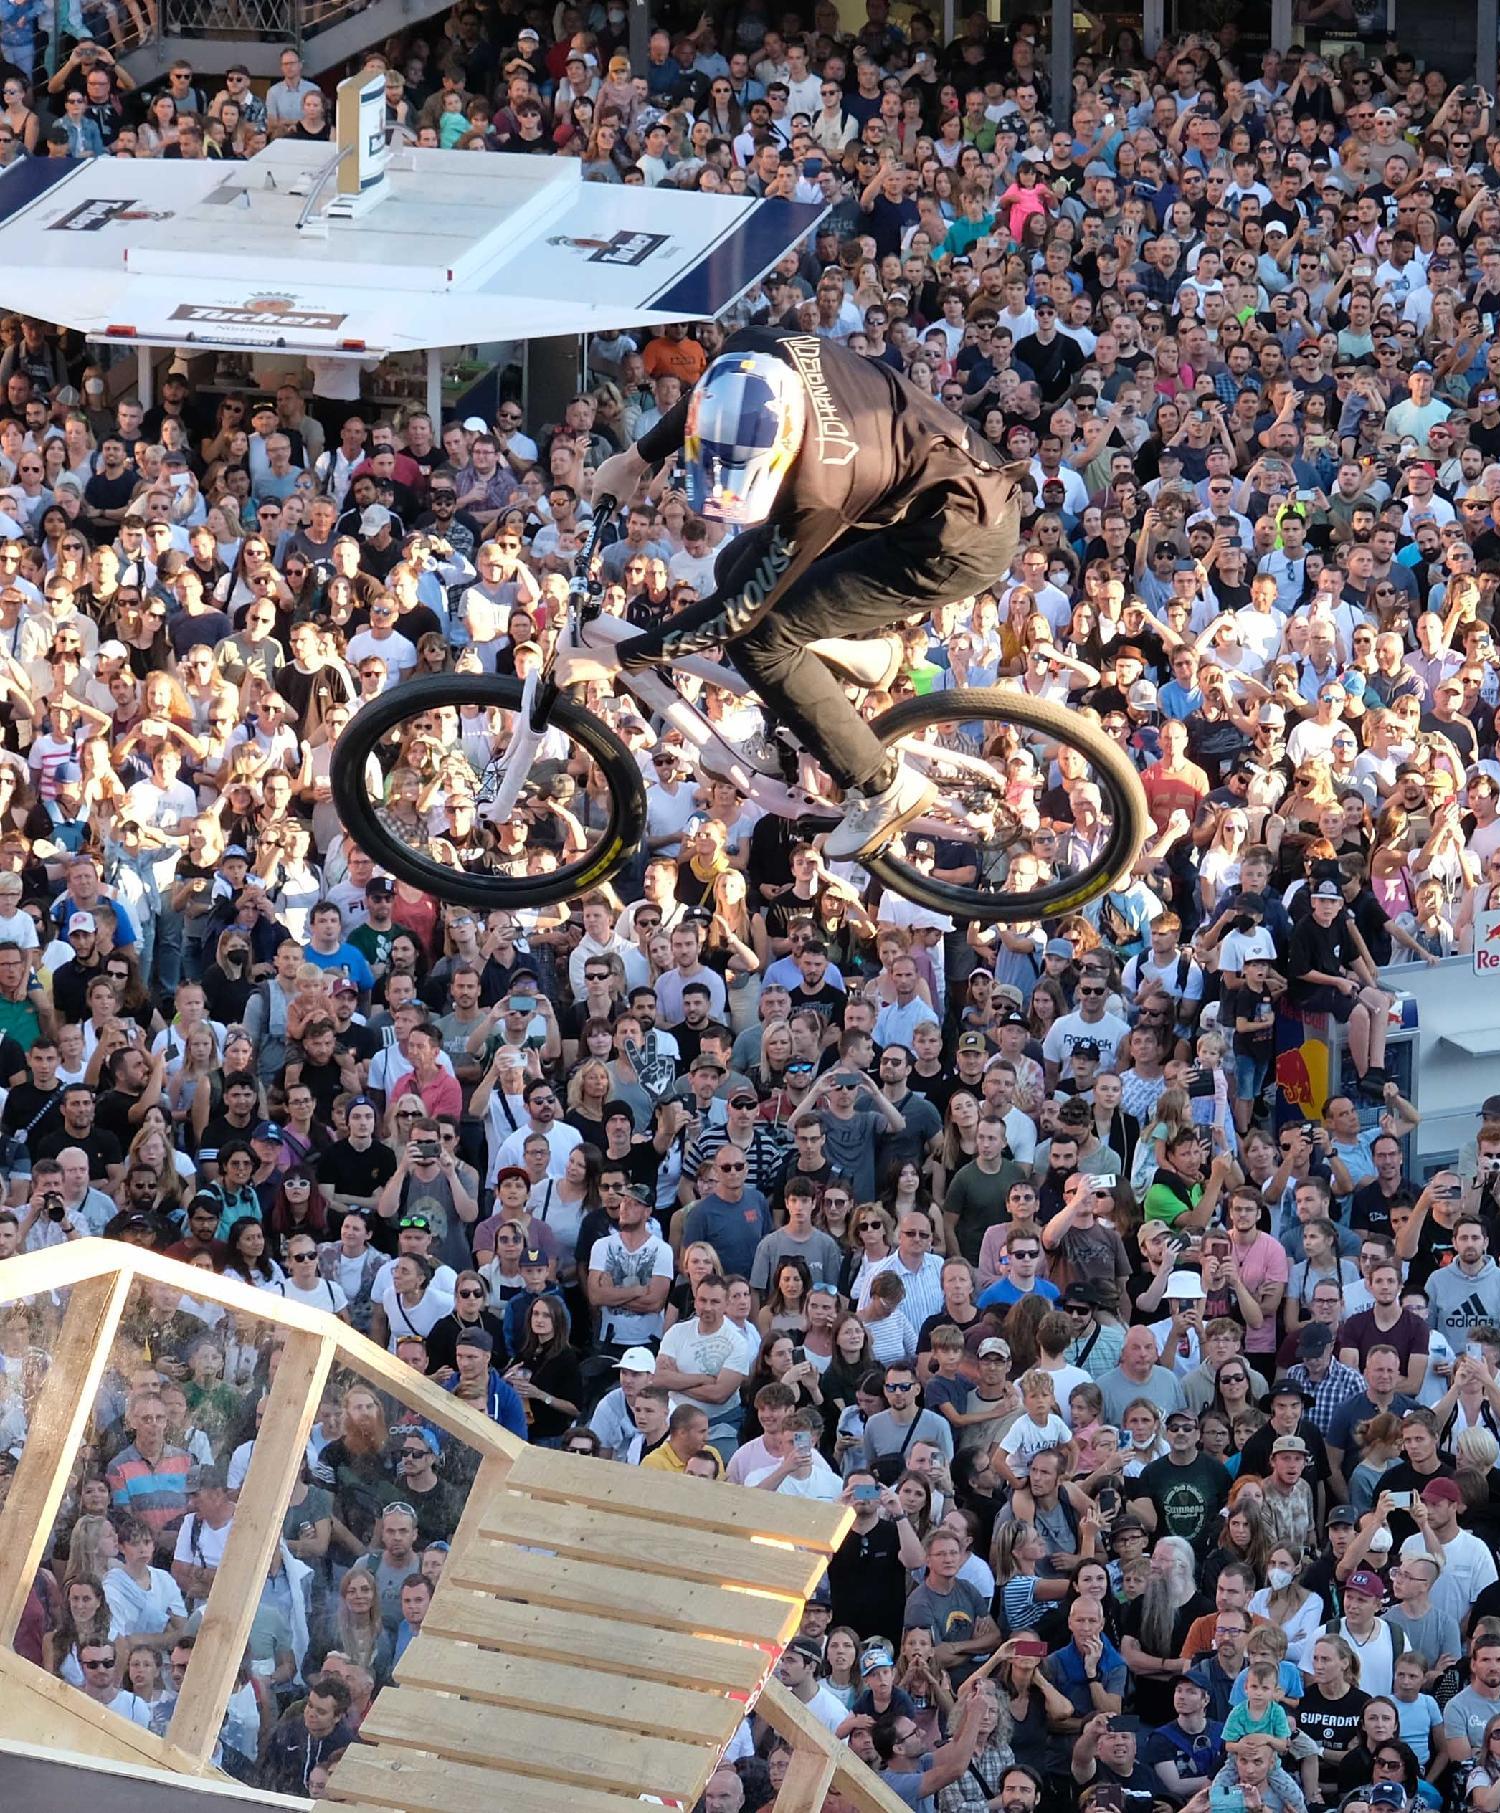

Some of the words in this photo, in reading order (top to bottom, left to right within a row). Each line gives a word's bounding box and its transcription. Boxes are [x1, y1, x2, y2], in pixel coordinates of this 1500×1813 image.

[187, 307, 332, 326] Tucher
[1446, 1313, 1494, 1328] adidas
[1301, 1712, 1360, 1727] SUPERDRY
